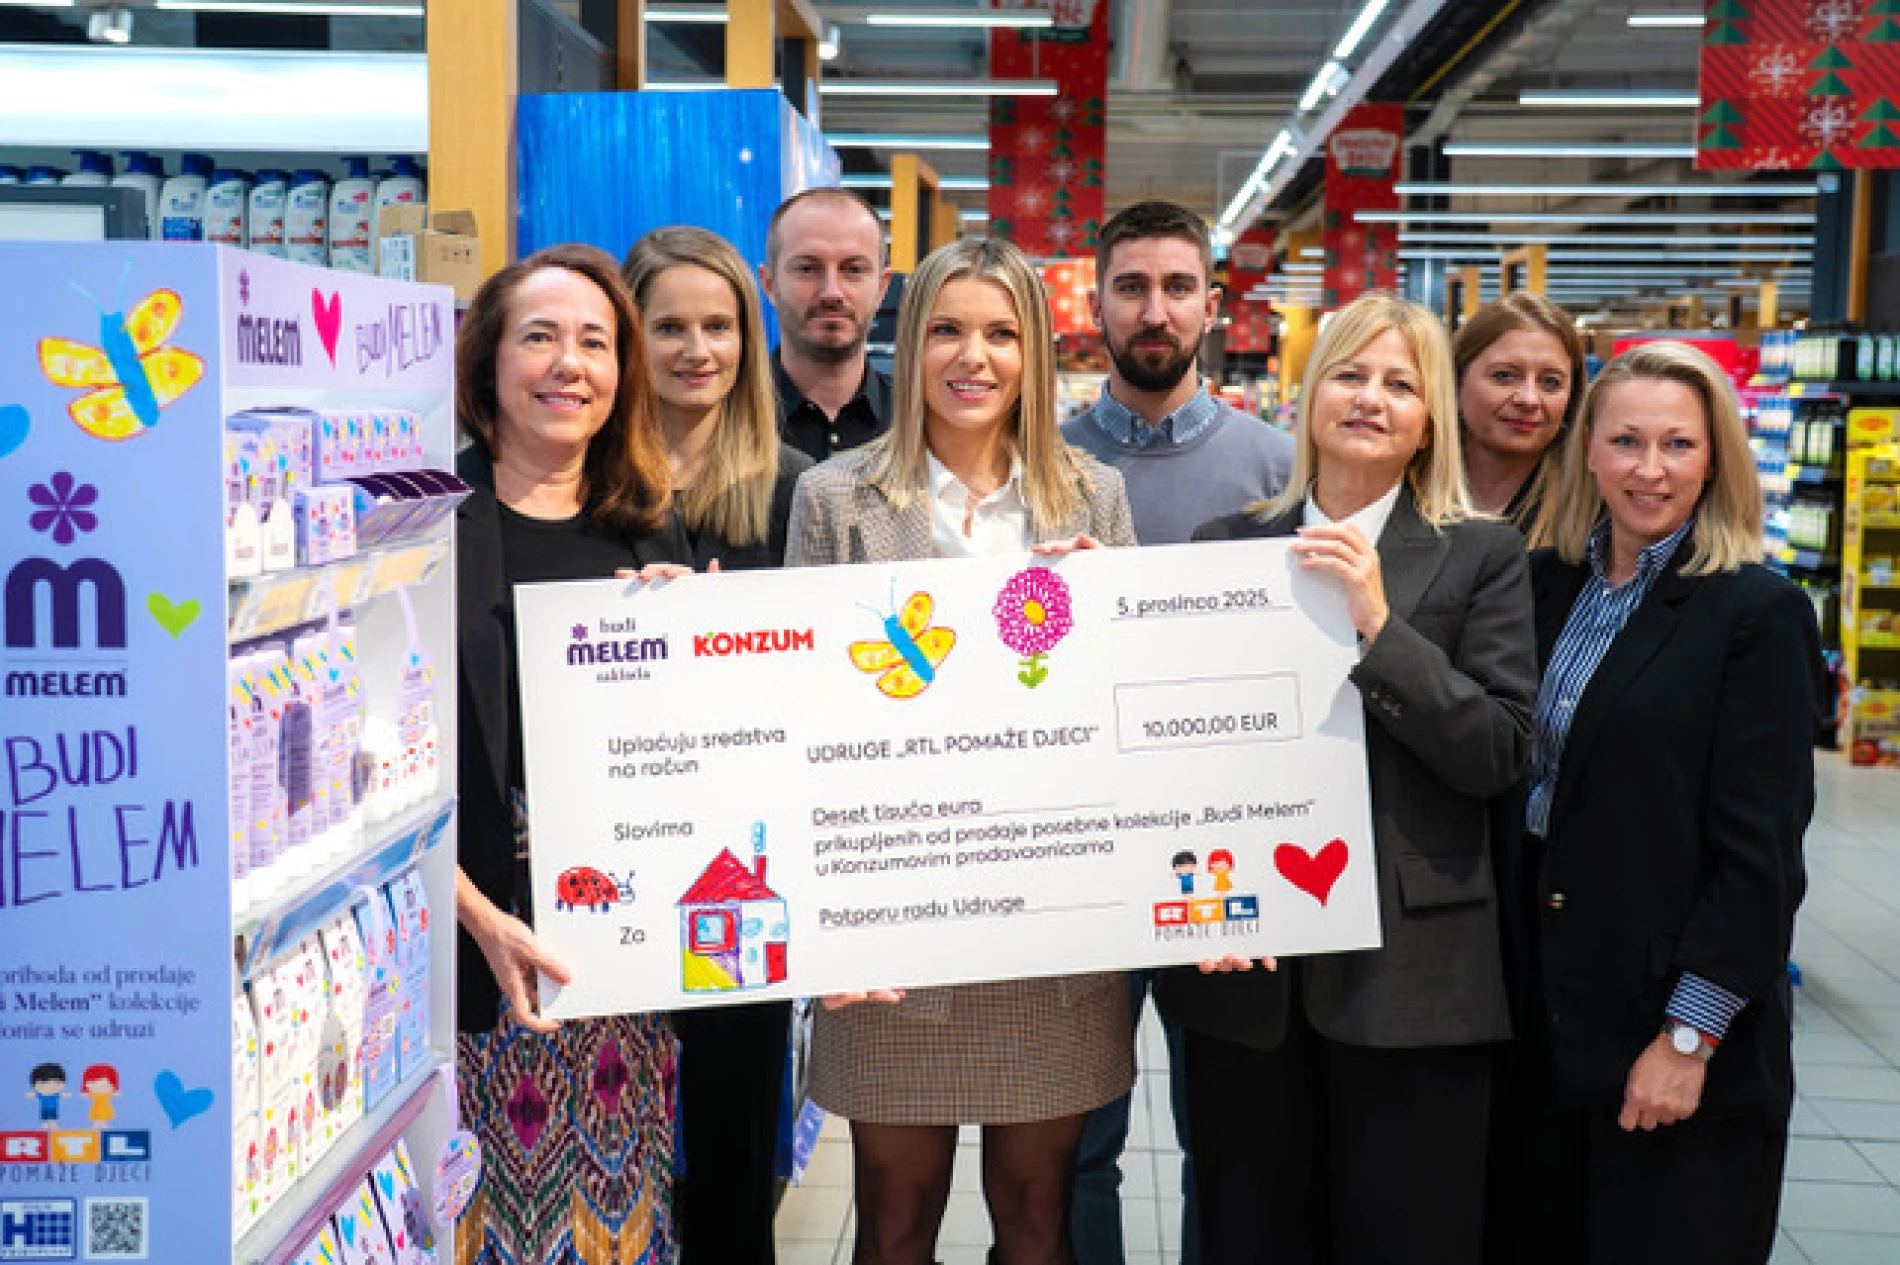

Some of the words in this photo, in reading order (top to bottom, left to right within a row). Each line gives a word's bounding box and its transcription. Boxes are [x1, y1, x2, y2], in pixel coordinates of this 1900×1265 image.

[1116, 596, 1135, 615] 5.
[1136, 593, 1218, 618] prosinca
[567, 637, 669, 665] MELEM
[692, 627, 815, 657] KONZUM
[5, 670, 128, 698] MELEM
[1142, 714, 1237, 738] 10.000,00
[1240, 712, 1279, 732] EUR
[607, 731, 698, 757] Uplaćuju
[700, 727, 787, 749] sredstva
[806, 739, 891, 762] UDRUGE
[944, 727, 1028, 753] POMAŽE
[5, 724, 138, 807] BUDI
[608, 763, 636, 778] na
[641, 757, 699, 776] račun
[812, 804, 870, 826] Deset
[874, 799, 932, 822] tisuća
[937, 800, 983, 818] eura
[614, 820, 694, 841] Slovima
[815, 830, 923, 856] prikupljenih
[926, 828, 951, 845] od
[955, 822, 1027, 843] prodaje
[1032, 816, 1110, 839] posebne
[1113, 808, 1191, 829] kolekcije
[0, 799, 199, 909] ELEM
[815, 862, 829, 877] u
[830, 852, 951, 876] Konzumovim
[955, 839, 1115, 867] prodavaonicama
[819, 905, 900, 928] Potporu
[902, 900, 948, 920] radu
[952, 896, 1026, 916] Udruge
[1155, 897, 1258, 925] RTL
[620, 926, 645, 944] Za
[82, 965, 110, 984] od
[115, 965, 197, 989] prodaje
[108, 991, 201, 1015] kolekcije
[61, 1023, 84, 1040] se
[2, 1133, 149, 1160] RTL
